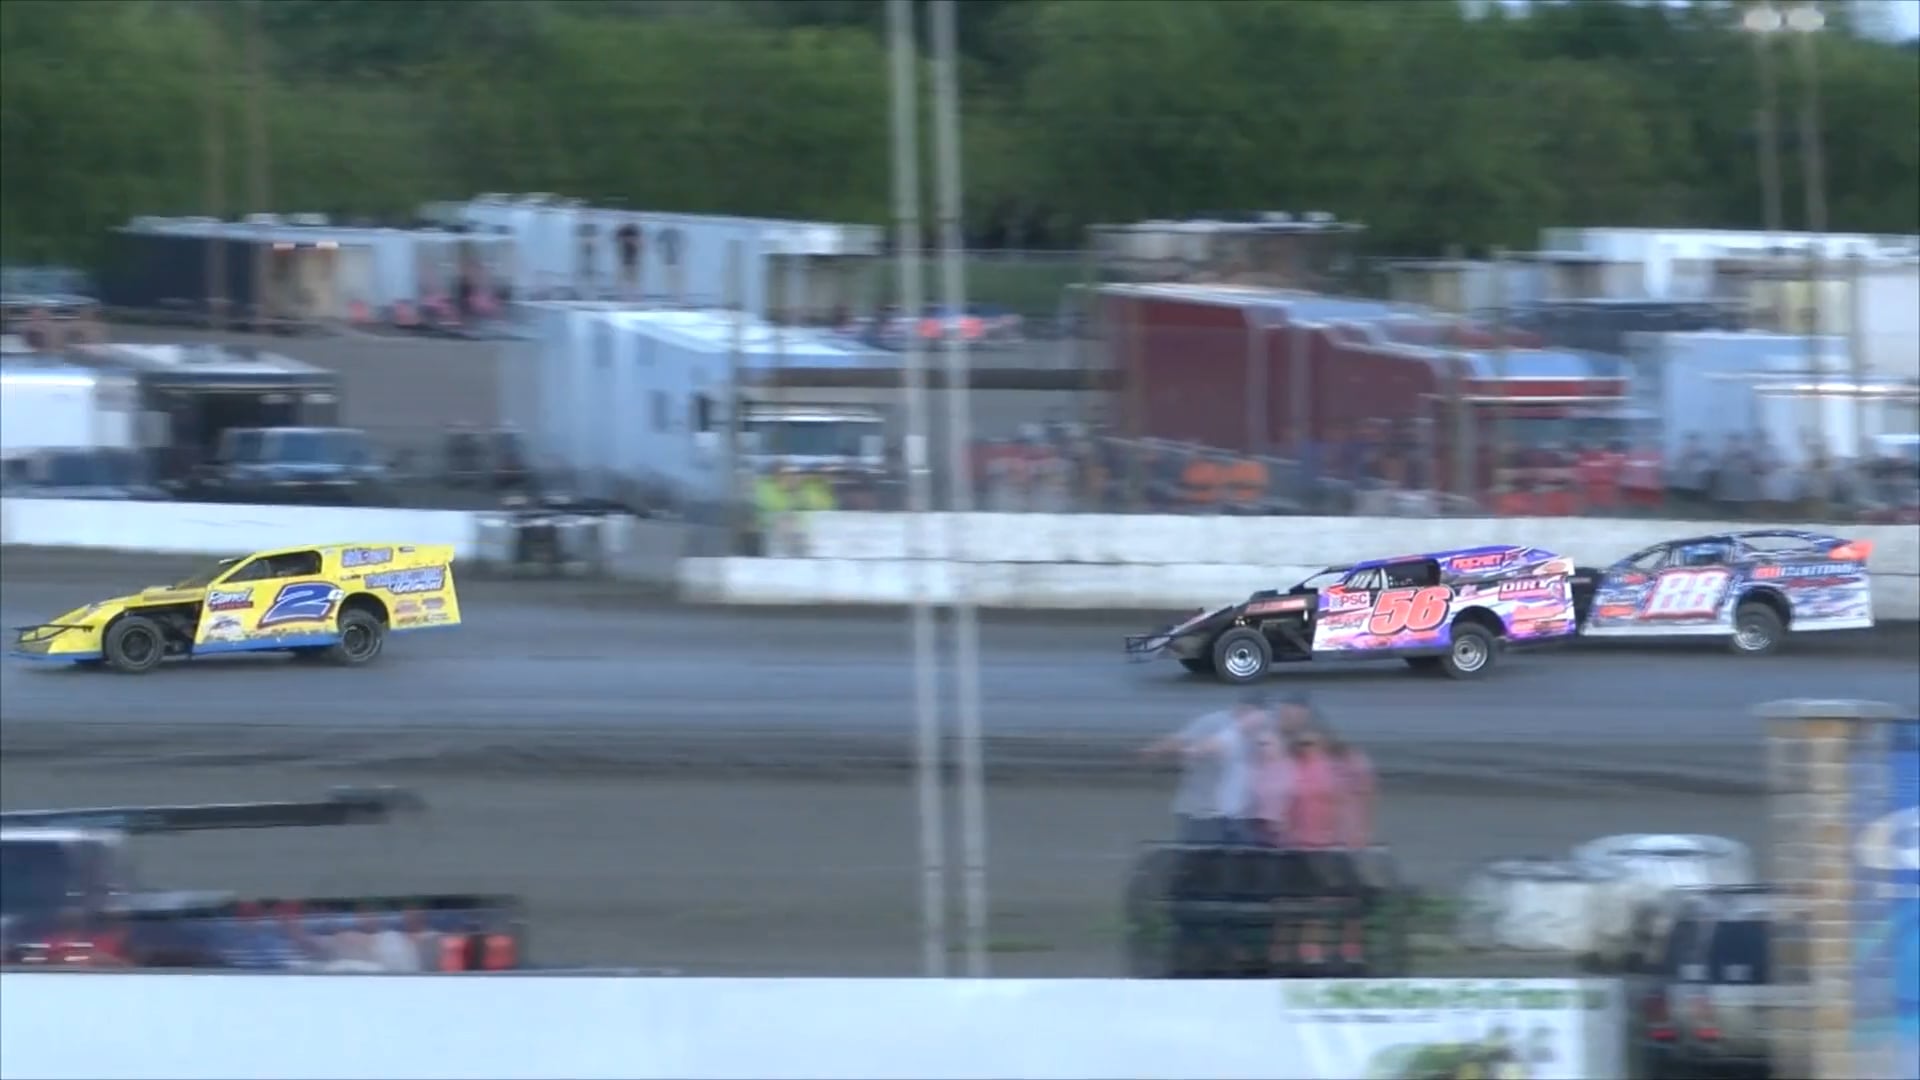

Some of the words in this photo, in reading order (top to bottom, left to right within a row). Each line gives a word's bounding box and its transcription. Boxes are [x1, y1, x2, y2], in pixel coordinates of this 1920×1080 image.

[1341, 593, 1368, 607] PSC
[1370, 584, 1455, 635] 56
[1645, 567, 1728, 618] 88
